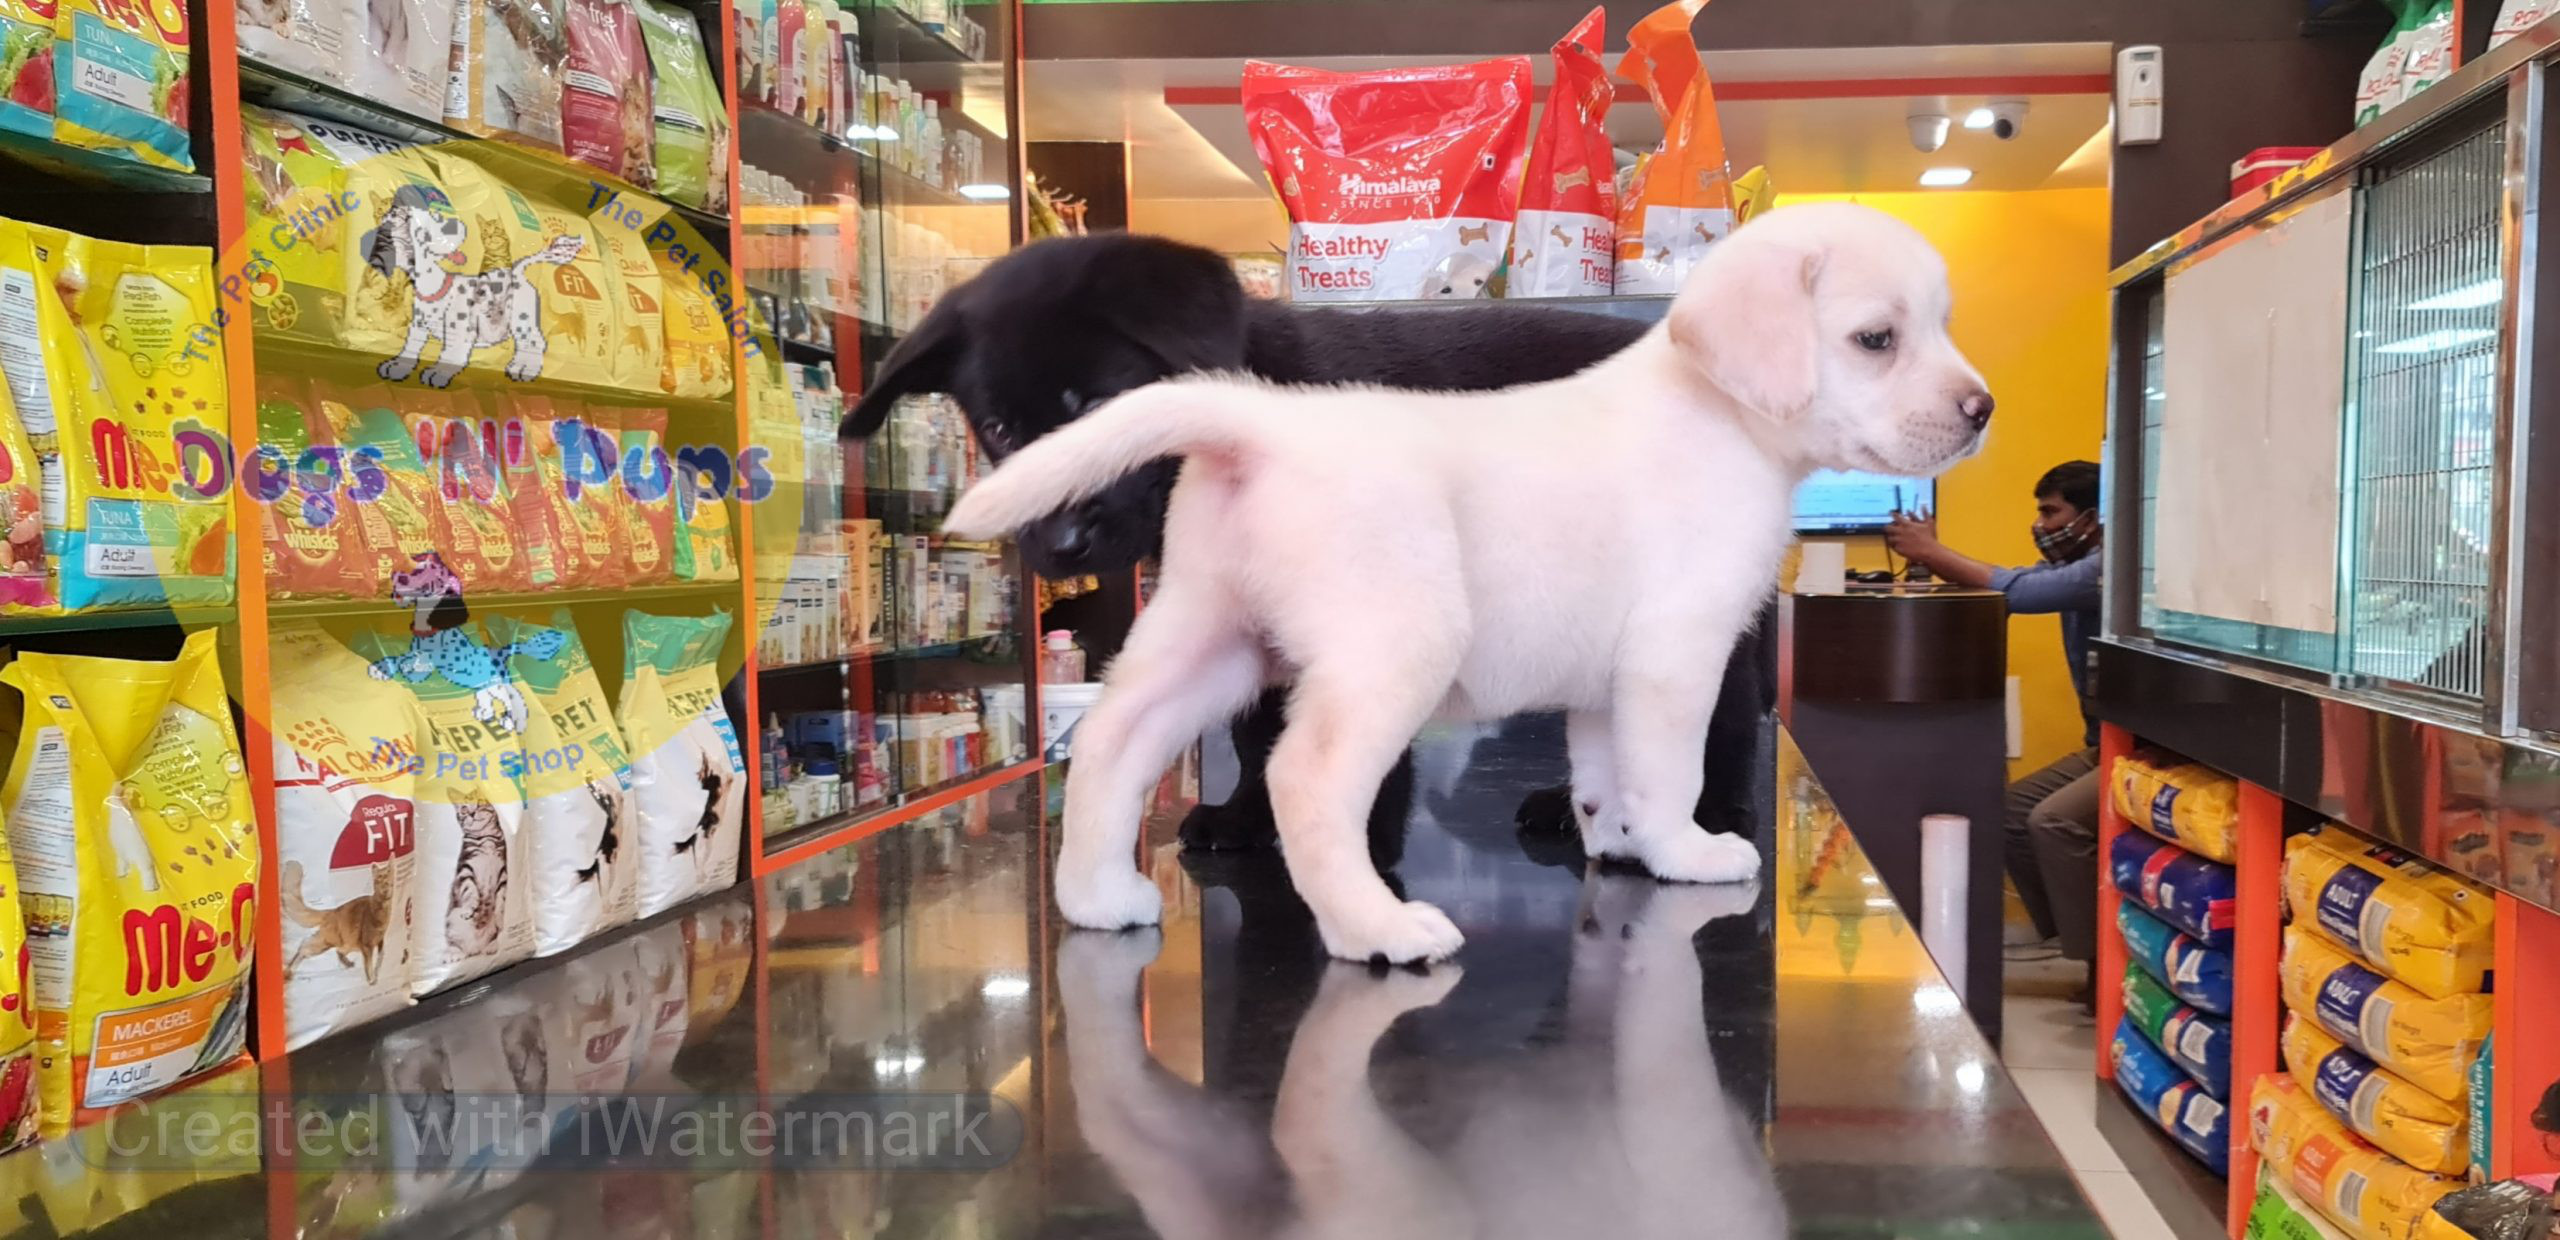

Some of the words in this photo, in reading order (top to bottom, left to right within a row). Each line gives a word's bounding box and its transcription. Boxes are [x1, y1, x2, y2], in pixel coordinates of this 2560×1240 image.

[1339, 173, 1441, 196] Himalaya
[1340, 198, 1393, 210] SINCE
[1298, 235, 1389, 260] Healthy
[561, 274, 586, 294] FIT
[1298, 266, 1372, 288] Treats
[284, 528, 340, 552] whiskas
[362, 802, 397, 818] Regula
[364, 812, 408, 855] FIT
[190, 890, 224, 909] FOOD
[106, 1062, 153, 1087] Adult
